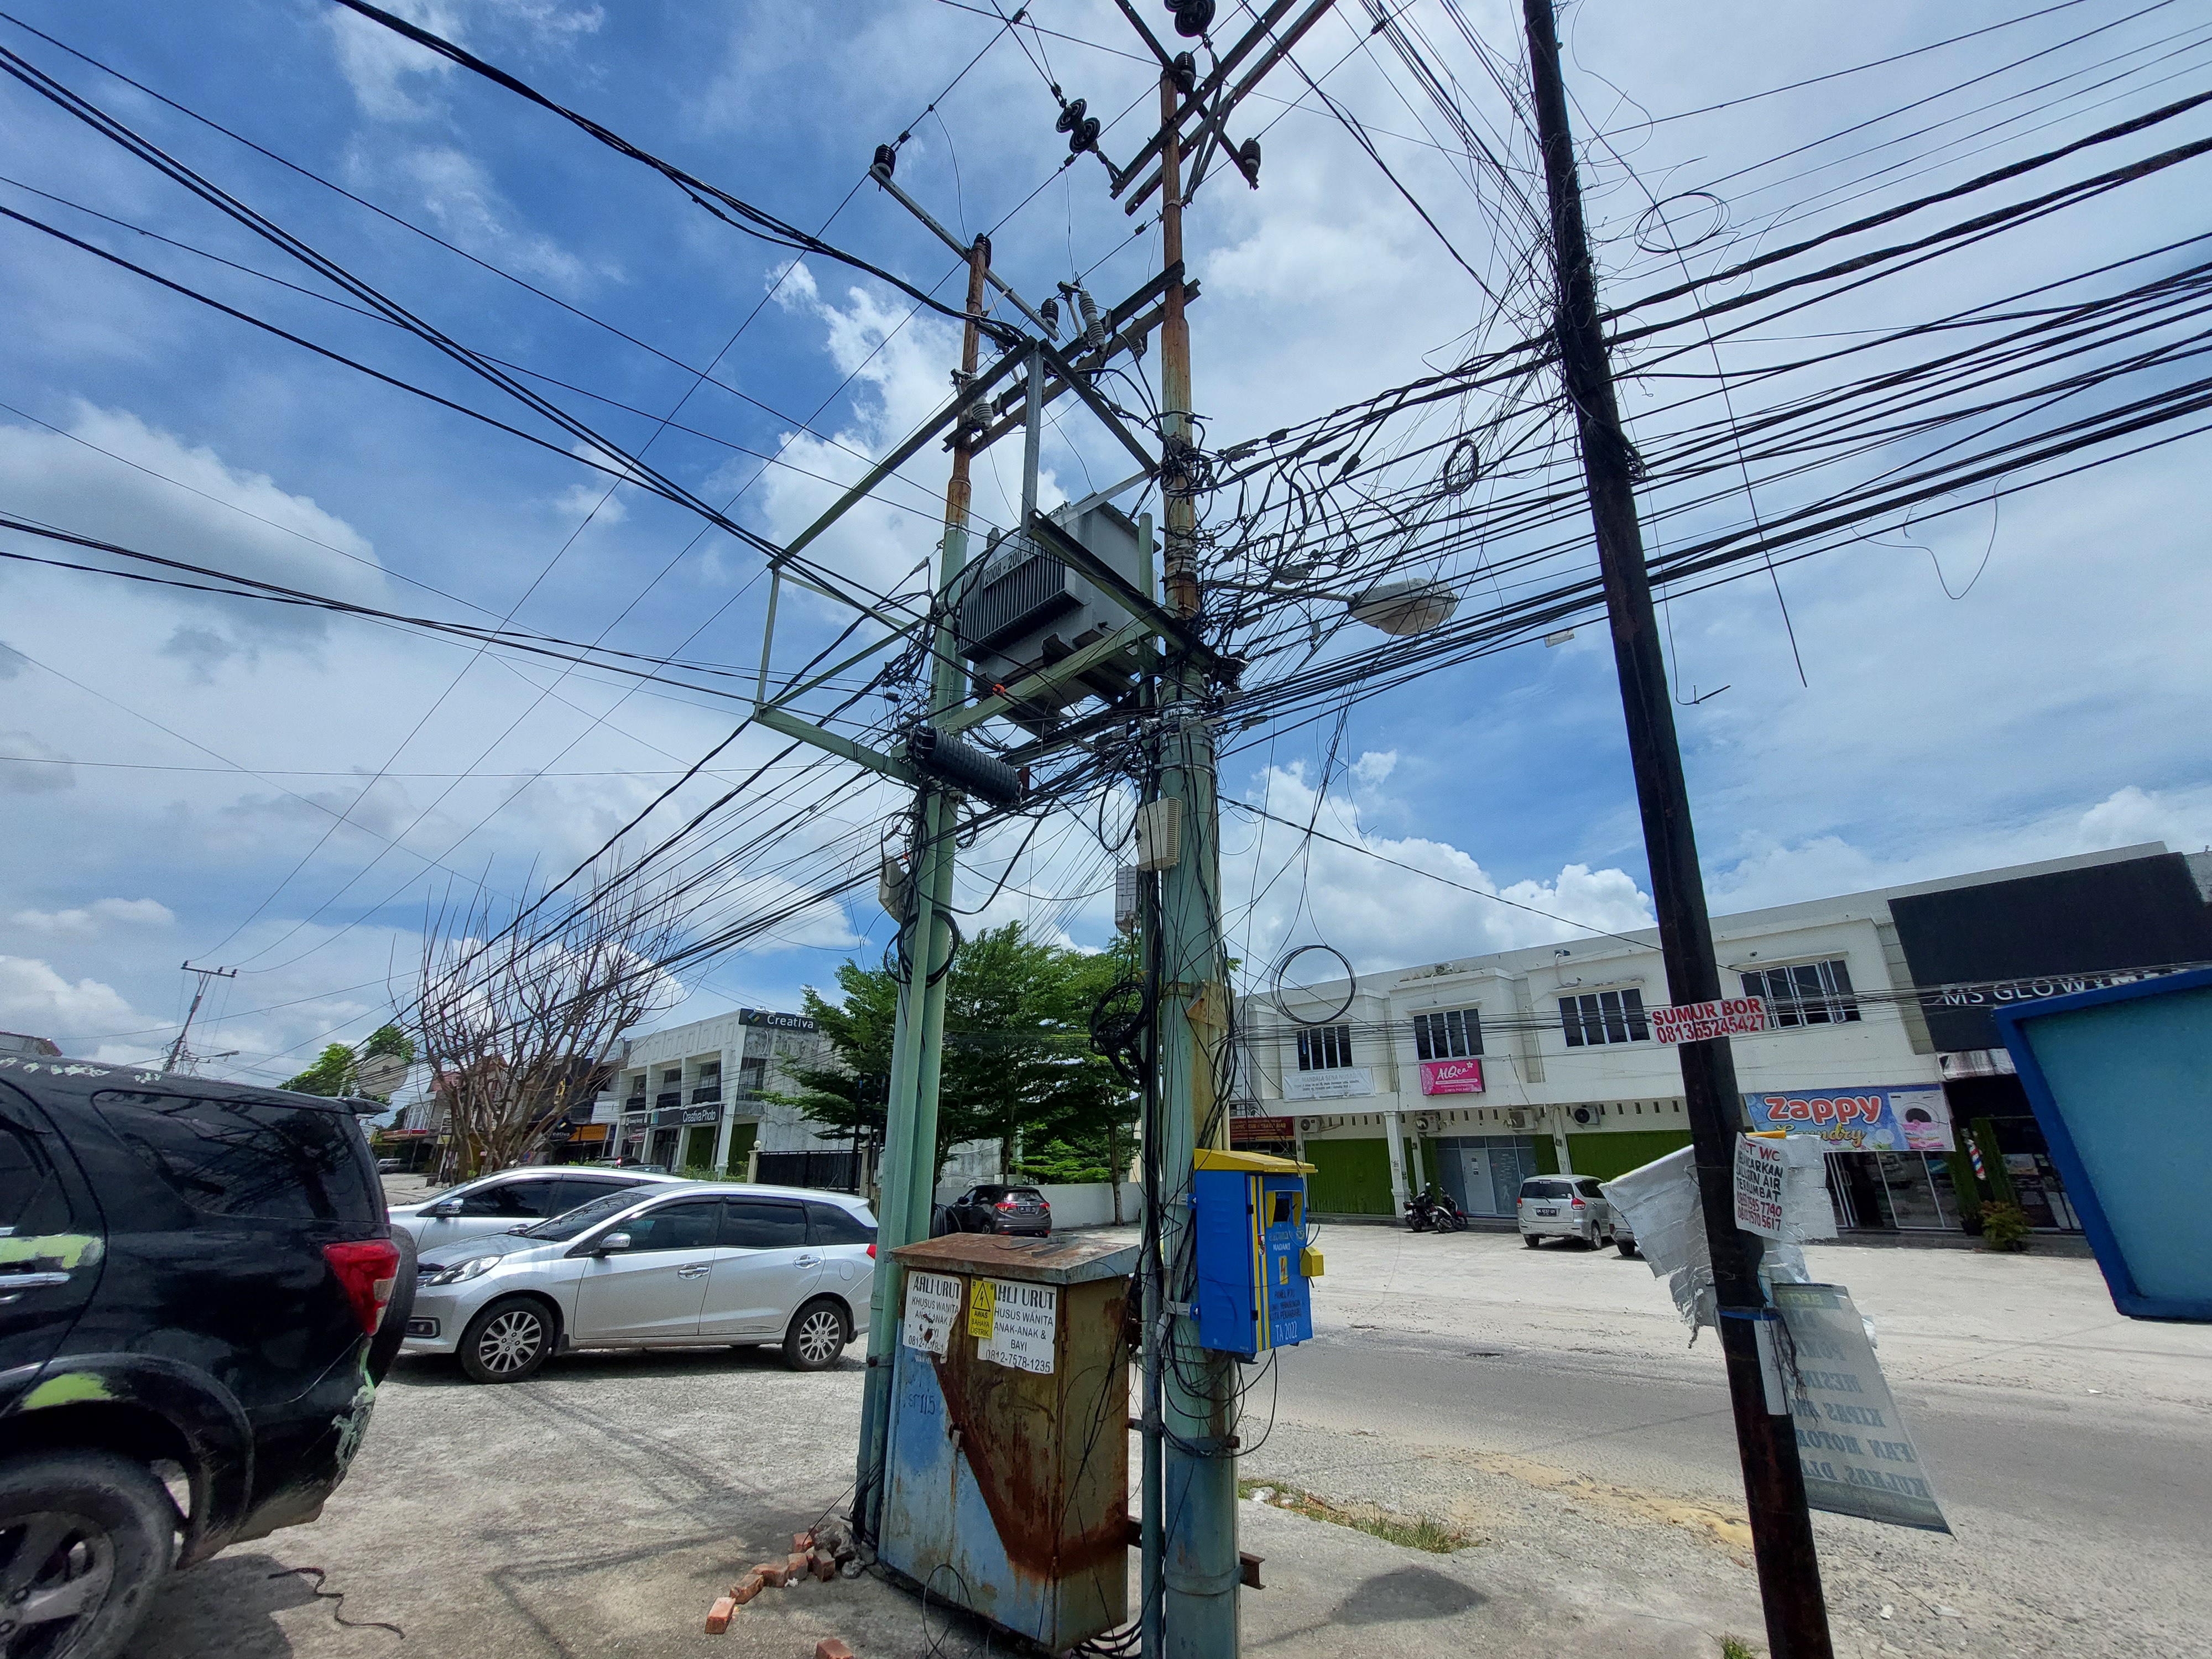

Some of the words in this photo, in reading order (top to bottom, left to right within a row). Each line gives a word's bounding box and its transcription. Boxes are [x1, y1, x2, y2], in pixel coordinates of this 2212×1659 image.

[984, 562, 1001, 586] 2008
[1008, 550, 1021, 570] 200
[1993, 977, 2086, 1001] GLOW
[766, 1014, 814, 1029] Creativa
[1652, 1003, 1718, 1026] SUMUR
[1720, 998, 1762, 1016] BOR
[701, 1109, 716, 1121] Photo
[1764, 1094, 1882, 1126] Zappy
[1760, 1146, 1781, 1161] WC
[1763, 1175, 1781, 1191] AIR
[912, 1276, 934, 1295] AHLI
[936, 1279, 961, 1300] URUT
[994, 1284, 1018, 1304] HLI
[1022, 1288, 1055, 1310] URUT
[911, 1295, 935, 1310] KHUSUS
[936, 1301, 959, 1314] WANITA
[971, 1318, 990, 1328] BAHAYA
[974, 1310, 988, 1319] AWAS
[994, 1307, 1021, 1321] HUSUS
[1022, 1311, 1053, 1327] WANITA
[971, 1328, 989, 1337] LISTRIK
[993, 1321, 1039, 1339] ANAK-ANAK
[1040, 1329, 1047, 1340] &
[1285, 1320, 1298, 1340] 2022
[1010, 1339, 1027, 1352] BAYI
